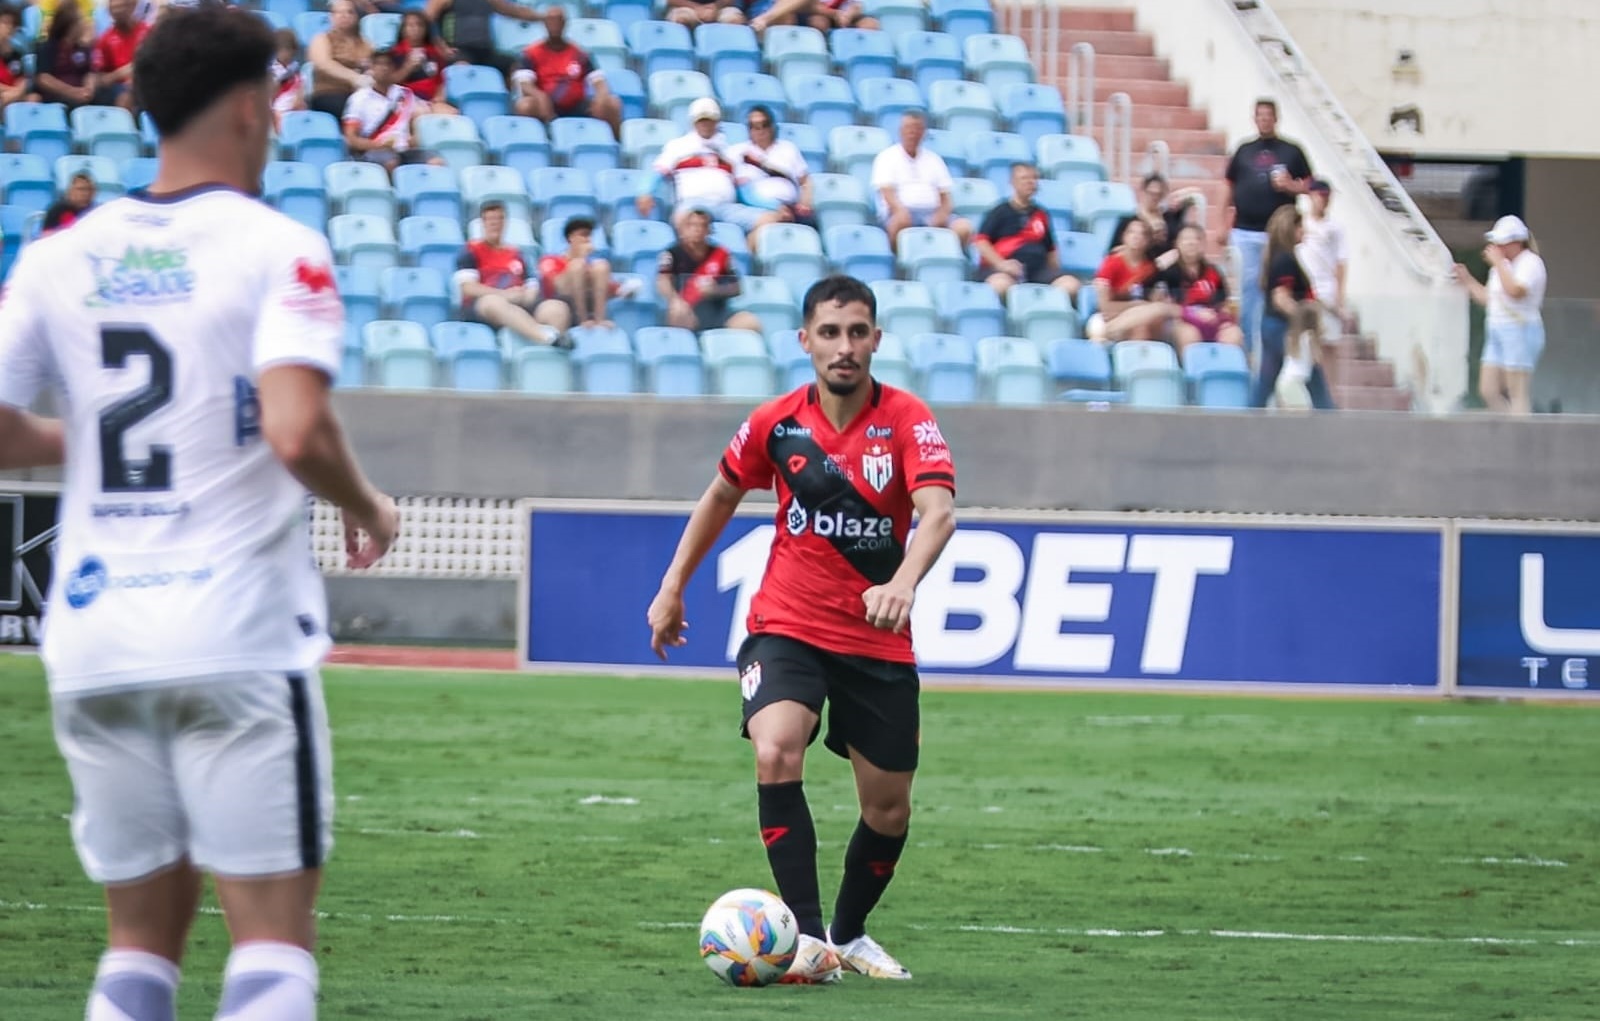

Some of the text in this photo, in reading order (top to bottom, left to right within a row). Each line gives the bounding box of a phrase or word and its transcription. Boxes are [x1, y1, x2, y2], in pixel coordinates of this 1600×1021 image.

[99, 323, 173, 492] 2
[814, 510, 892, 537] blaze
[854, 537, 892, 551] .com
[717, 524, 1234, 674] 1BET
